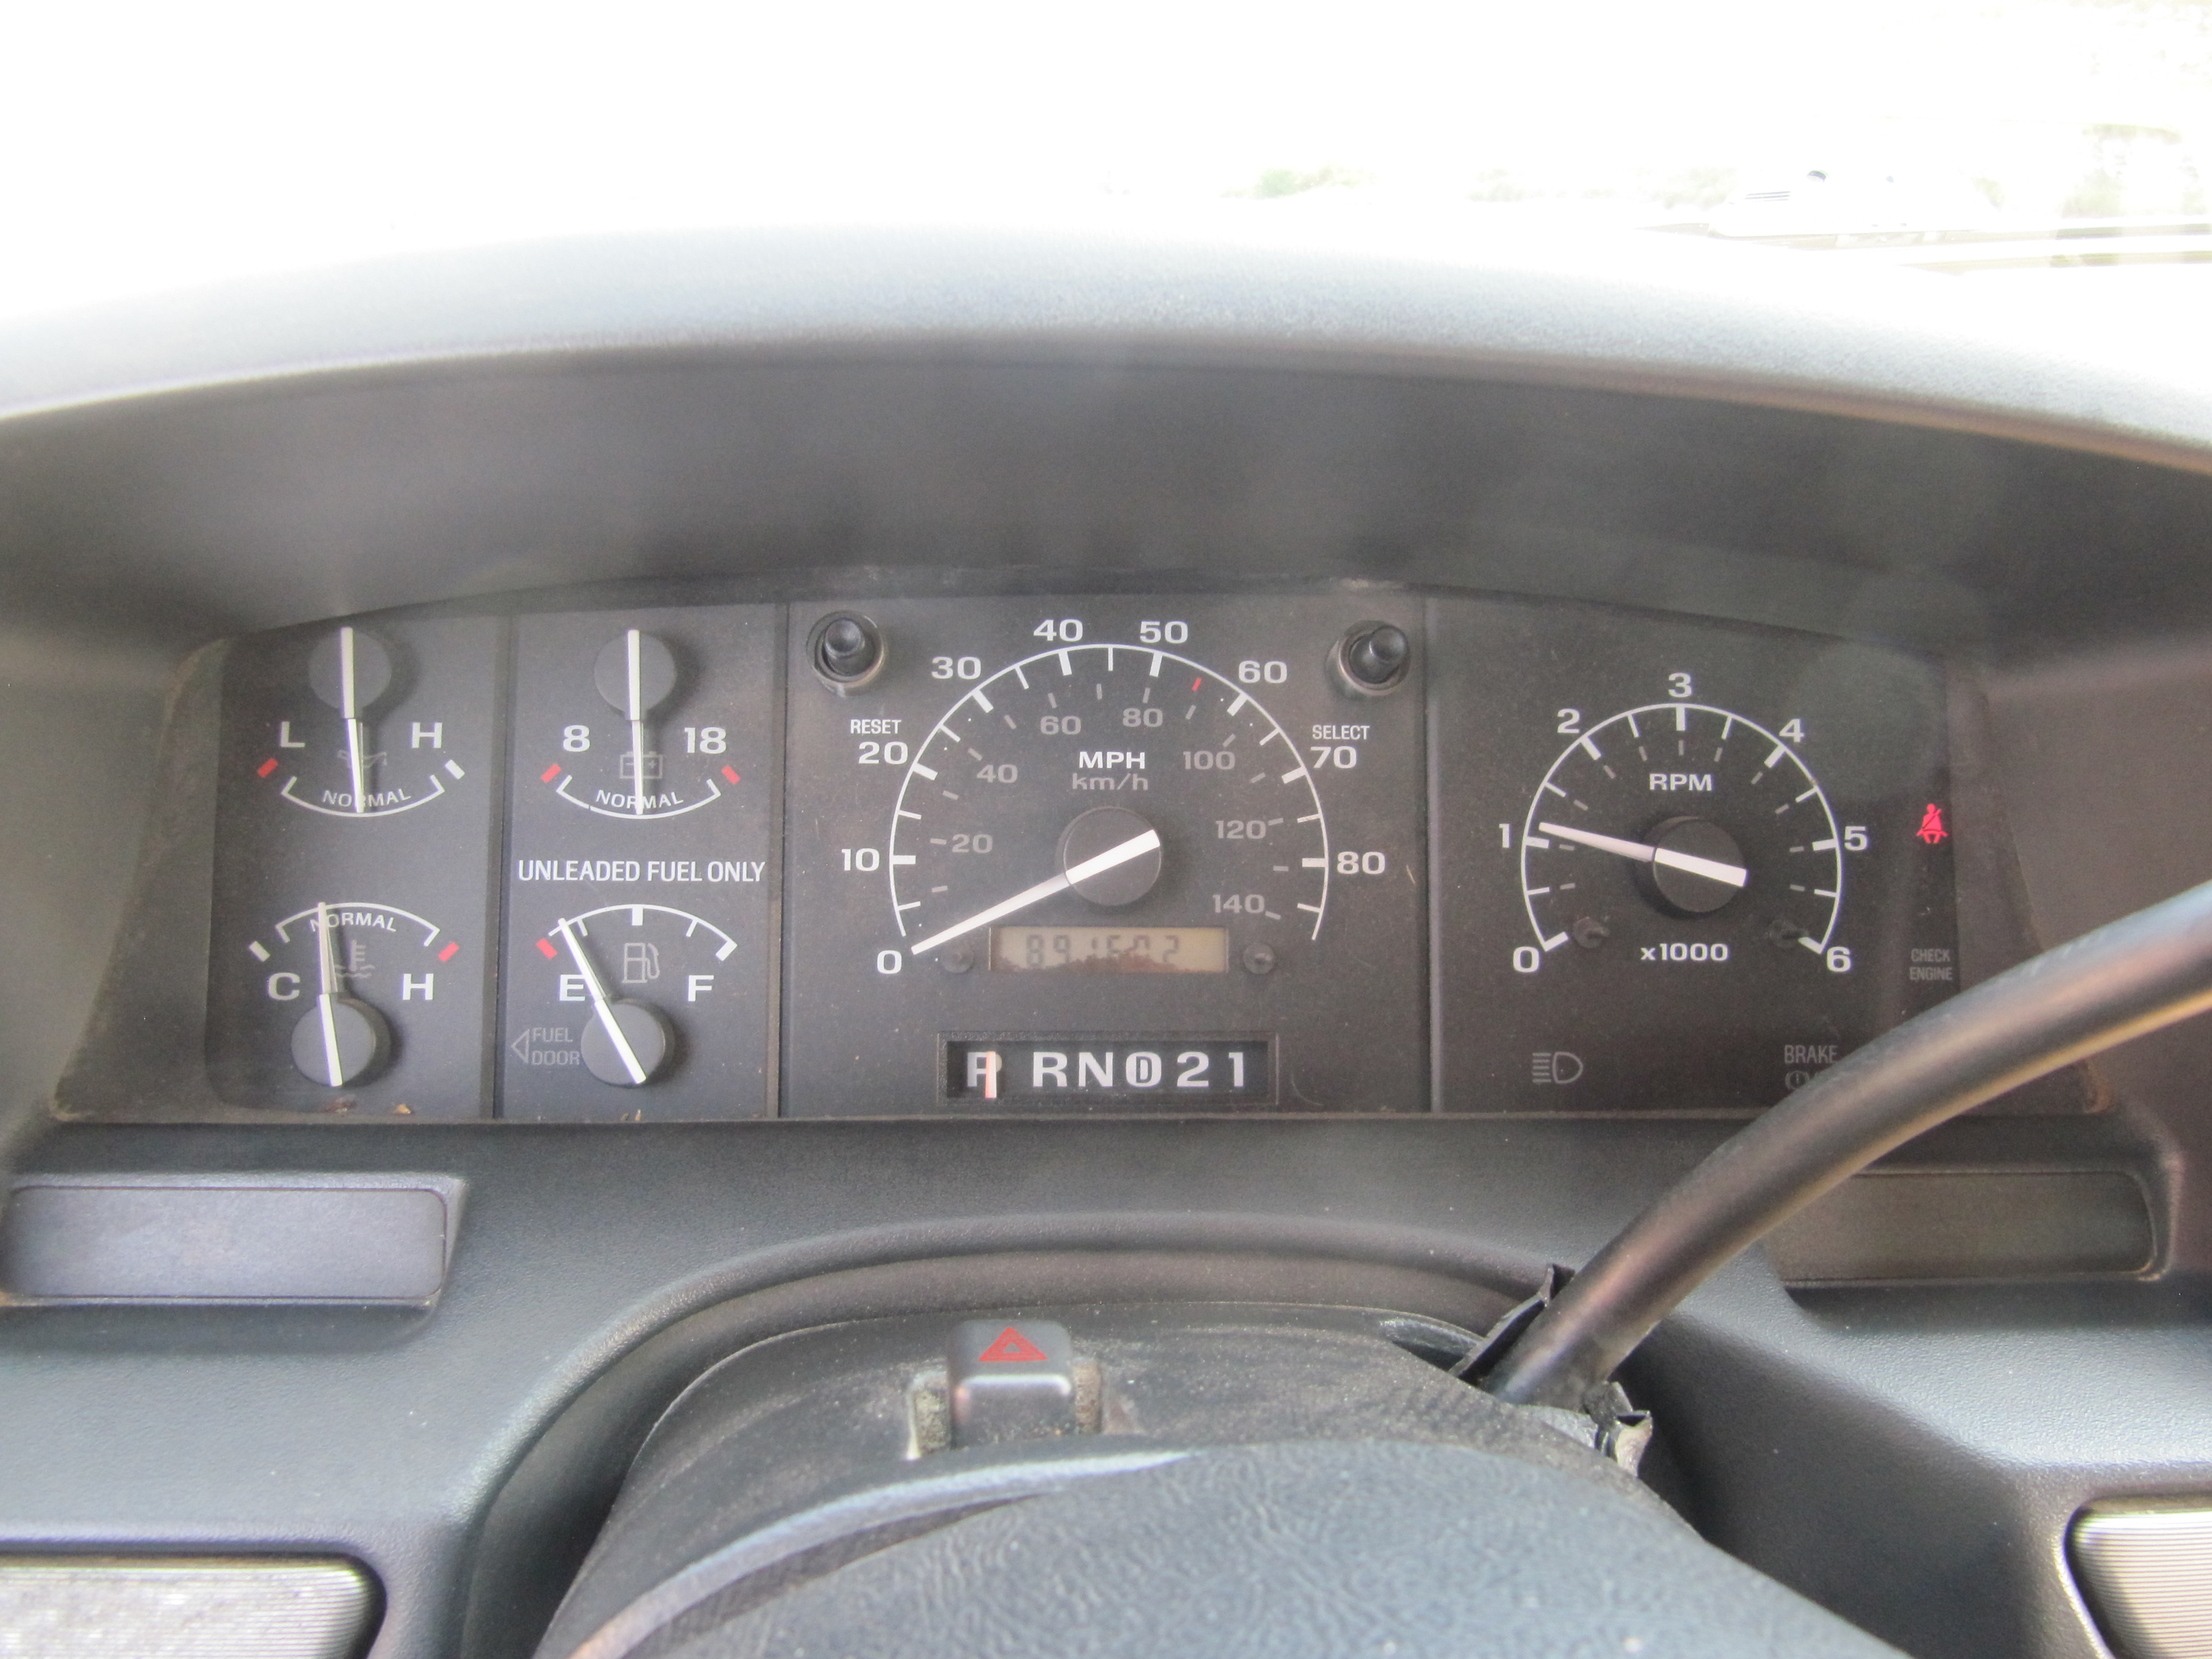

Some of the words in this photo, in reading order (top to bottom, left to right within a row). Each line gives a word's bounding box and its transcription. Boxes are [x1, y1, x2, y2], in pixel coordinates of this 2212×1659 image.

[1034, 619, 1083, 642] 40
[1139, 621, 1188, 644] 50
[931, 656, 982, 680] 30
[1238, 660, 1288, 684] 60
[1668, 672, 1692, 698] 3
[850, 719, 902, 734] RESET
[1040, 716, 1082, 735] 60
[1122, 708, 1164, 728] 80
[1557, 708, 1580, 733] 2
[280, 721, 305, 748] L
[411, 722, 442, 749] H
[562, 724, 591, 752] 8
[684, 727, 727, 754] 18
[1312, 725, 1370, 740] SELECT
[1779, 718, 1804, 743] 4
[858, 742, 909, 765] 20
[1078, 751, 1146, 769] MPH
[1182, 750, 1236, 770] 100
[1310, 746, 1357, 769] 70
[976, 764, 1019, 784] 40
[1072, 773, 1149, 791] km/h
[1649, 773, 1713, 791] RPM
[322, 789, 411, 807] NOMAL
[1215, 820, 1266, 839] 120
[1498, 823, 1511, 848] 1
[1844, 826, 1869, 851] 5
[951, 834, 993, 853] 20
[518, 860, 640, 881] UNLEADED
[648, 860, 702, 881] FUEL
[707, 861, 766, 882] ONLY
[841, 848, 880, 872] 10
[1337, 851, 1386, 874] 80
[1212, 894, 1265, 914] 140
[877, 950, 902, 974] 0
[1512, 946, 1540, 972] 0
[1640, 943, 1729, 961] x1000
[1827, 946, 1852, 972] 6
[1911, 948, 1951, 963] CHECK
[1909, 967, 1953, 981] ENGINE
[268, 972, 300, 1000] C
[402, 973, 434, 1000] H
[559, 974, 586, 1001] E
[687, 975, 714, 1001] F
[531, 1027, 573, 1042] FUEL
[531, 1050, 580, 1066] DOOR
[1783, 1045, 1838, 1065] BRAKE
